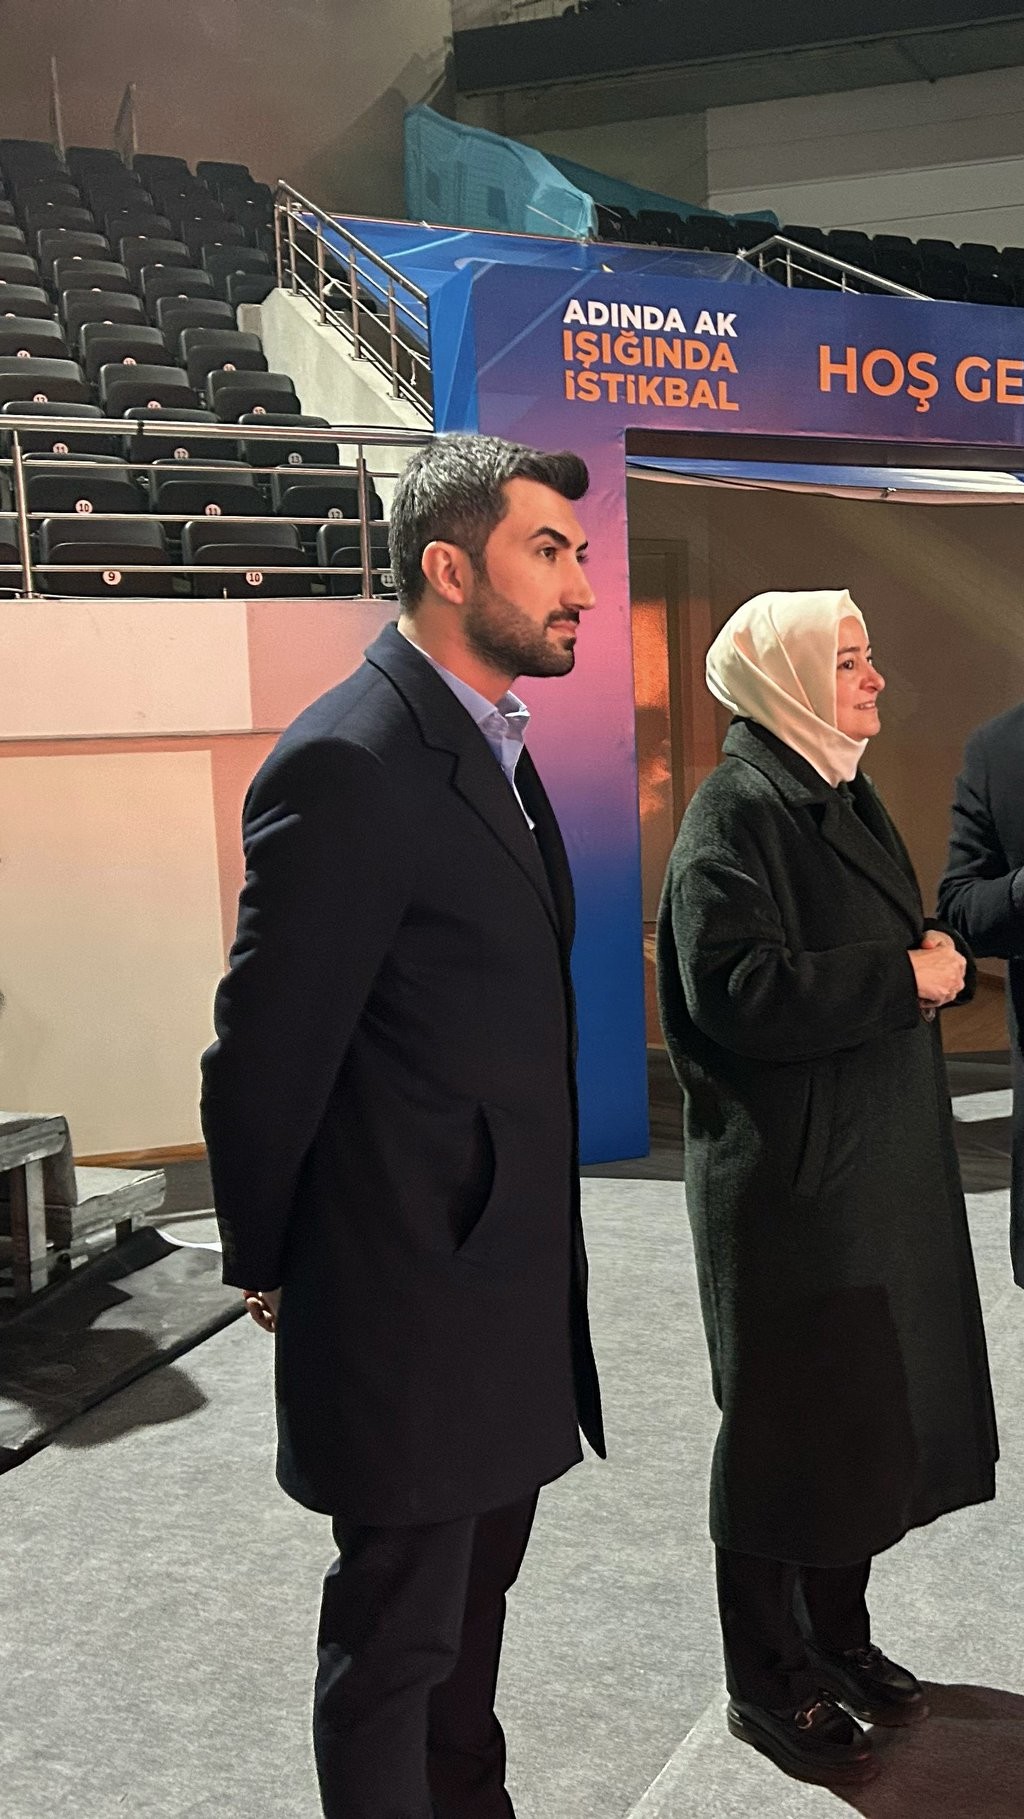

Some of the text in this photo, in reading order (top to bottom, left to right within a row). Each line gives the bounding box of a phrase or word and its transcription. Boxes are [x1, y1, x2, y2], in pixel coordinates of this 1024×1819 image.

[563, 299, 738, 337] ADINDA AK
[563, 330, 738, 374] IŞIĞINDA
[565, 370, 739, 411] İSTİKBAL
[819, 345, 939, 413] HOŞ
[79, 503, 90, 513] 10
[108, 572, 116, 581] 9
[248, 573, 260, 583] 10
